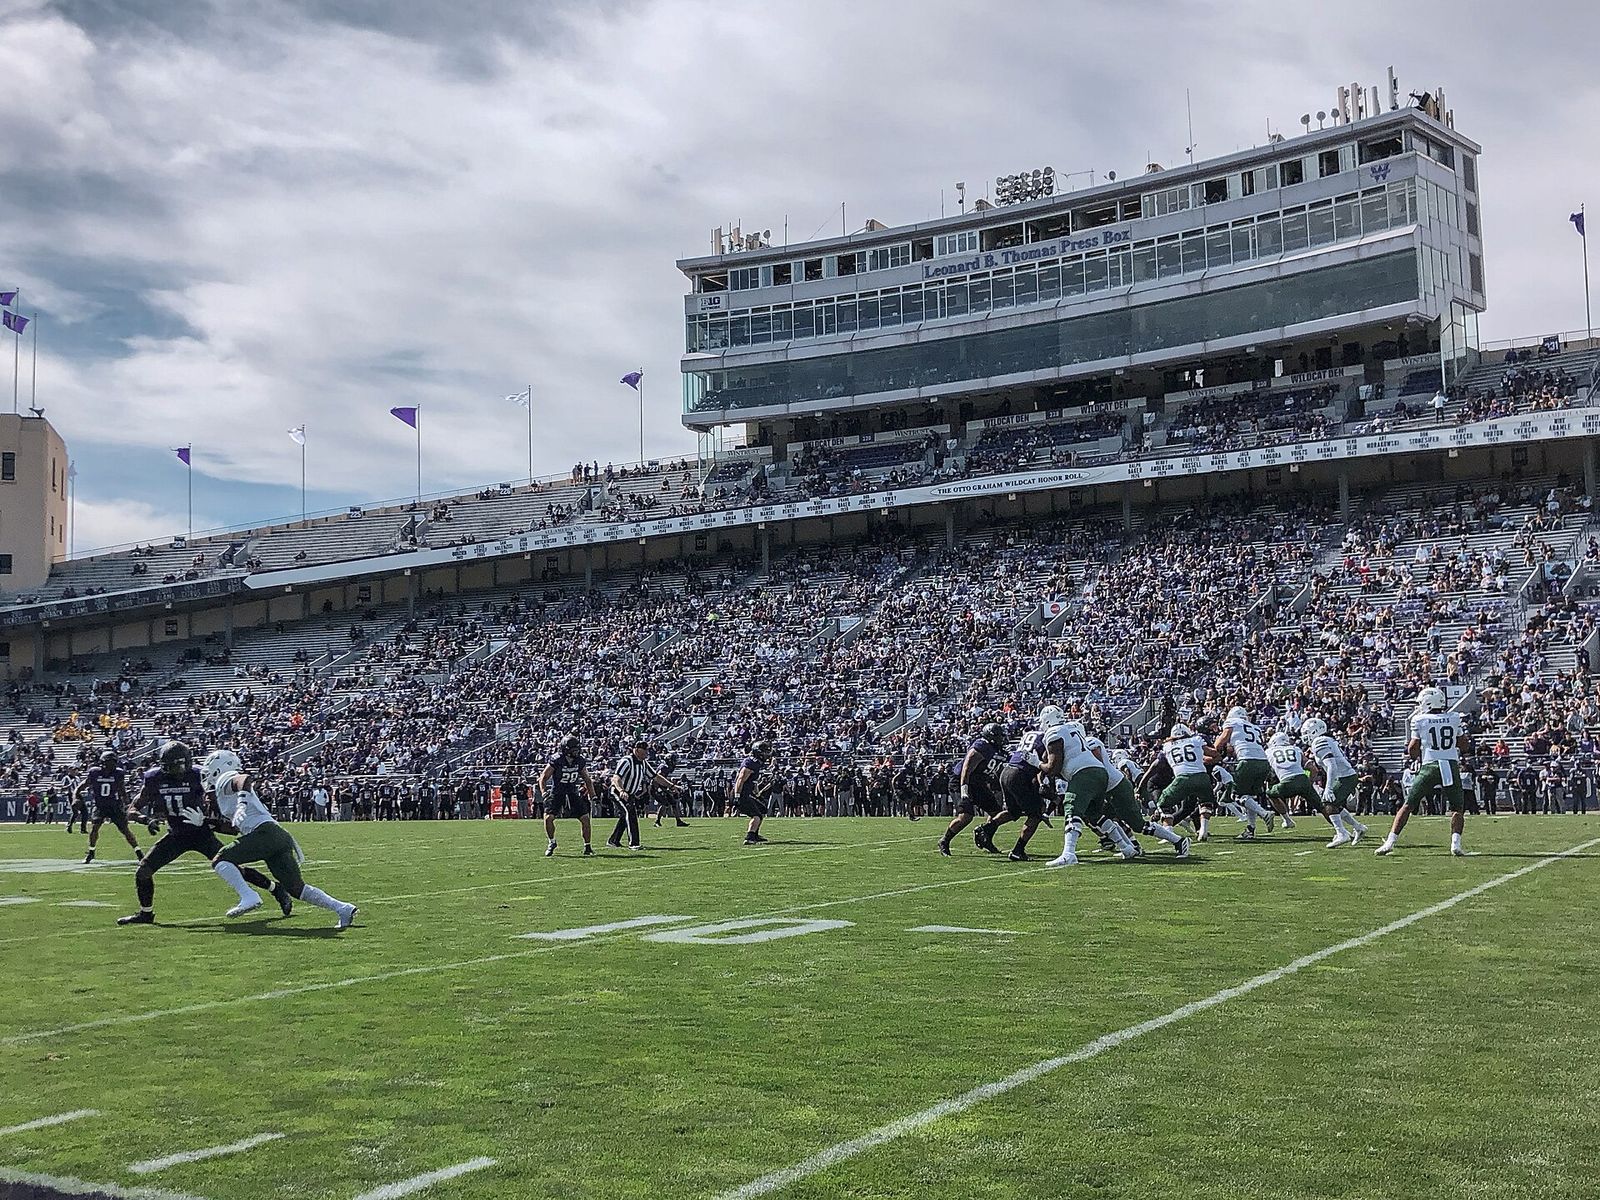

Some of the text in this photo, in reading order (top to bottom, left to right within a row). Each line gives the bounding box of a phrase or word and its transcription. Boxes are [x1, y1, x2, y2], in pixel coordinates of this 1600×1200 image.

[924, 229, 1130, 279] Leonard B. Thomas Press Box
[1291, 367, 1344, 384] WILDCAT DEN
[1080, 400, 1129, 415] WILDCAT DEN
[984, 413, 1030, 427] WILDCAT DEN
[1549, 423, 1571, 431] ADAMLE
[1582, 421, 1600, 429] HINTO
[832, 437, 845, 446] DEN
[953, 484, 972, 493] OTTO
[972, 481, 1003, 492] GRAHAM
[1004, 478, 1036, 488] WILDCAT
[1038, 475, 1063, 485] HONOR
[1065, 472, 1083, 481] ROLL
[1243, 724, 1263, 746] 53
[1429, 726, 1454, 751] 18
[1171, 744, 1197, 764] 66
[1273, 748, 1297, 764] 88
[101, 783, 111, 797] 0
[164, 795, 184, 817] 11
[511, 915, 854, 946] 10
